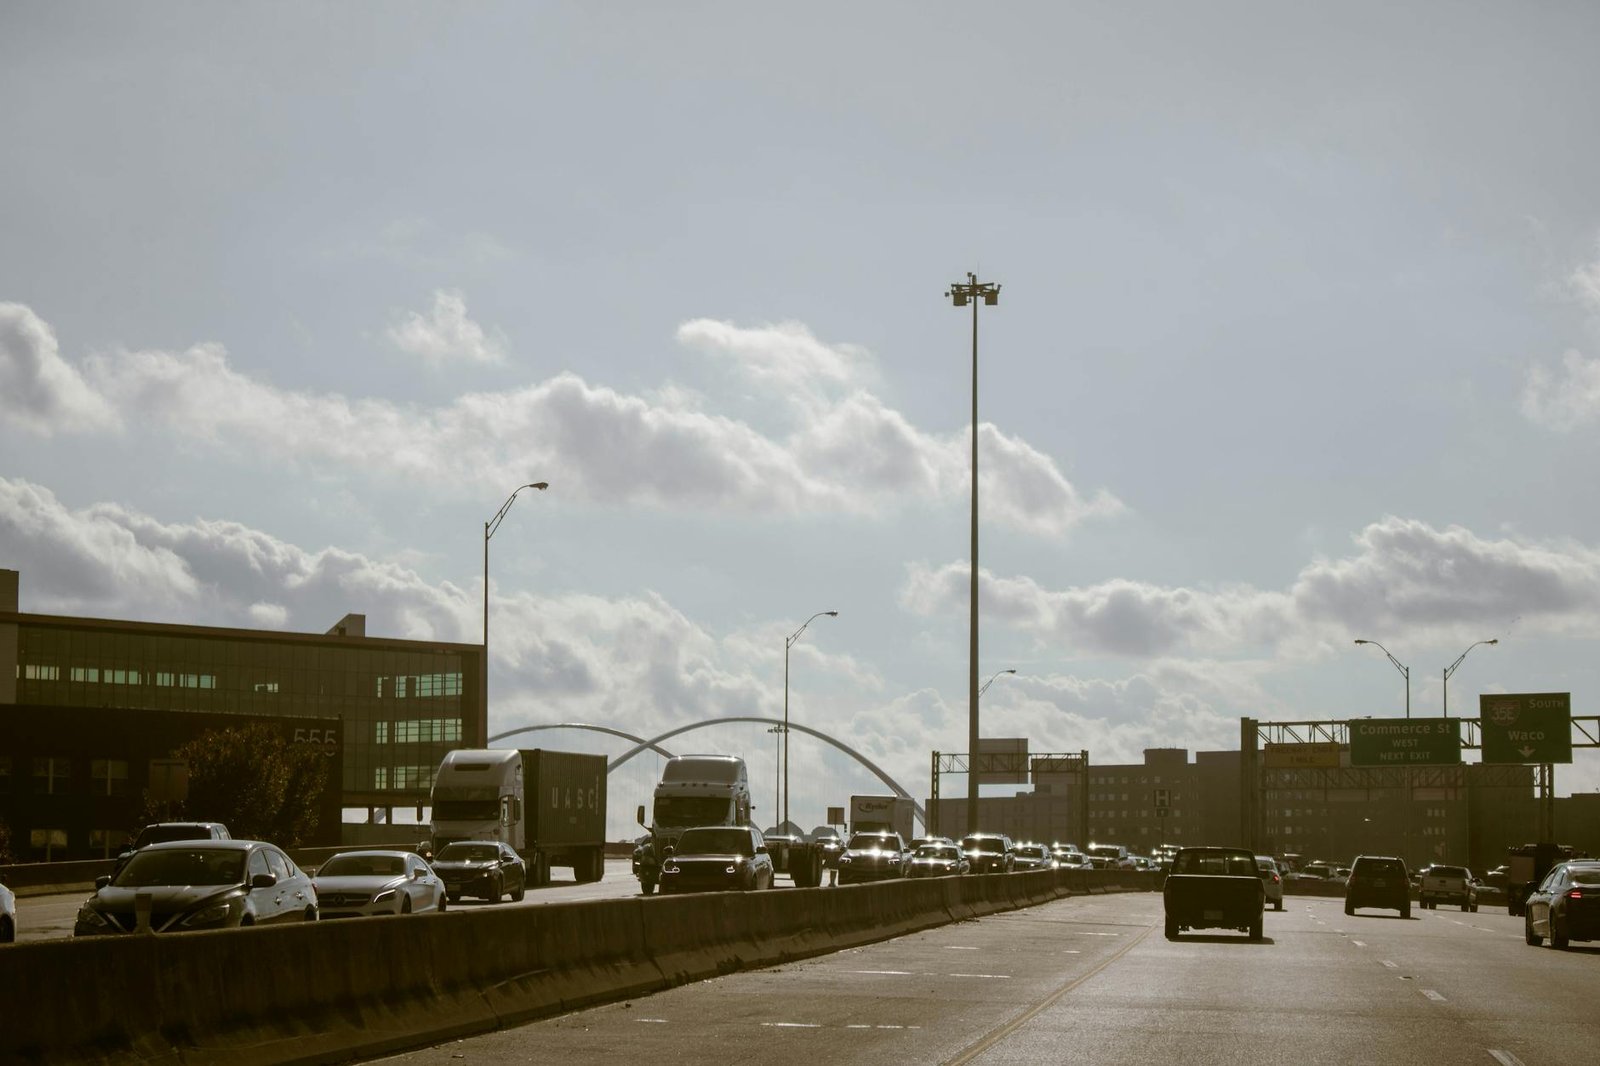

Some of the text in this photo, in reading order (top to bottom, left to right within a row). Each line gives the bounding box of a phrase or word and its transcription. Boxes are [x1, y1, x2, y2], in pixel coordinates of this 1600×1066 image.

[1529, 699, 1564, 709] SOUTH
[1491, 707, 1515, 720] 35E
[1360, 723, 1451, 735] Commerce St
[1508, 731, 1545, 741] Waco
[1392, 739, 1419, 748] WEST
[1380, 751, 1431, 761] NEXT EXIT
[1156, 790, 1169, 806] H
